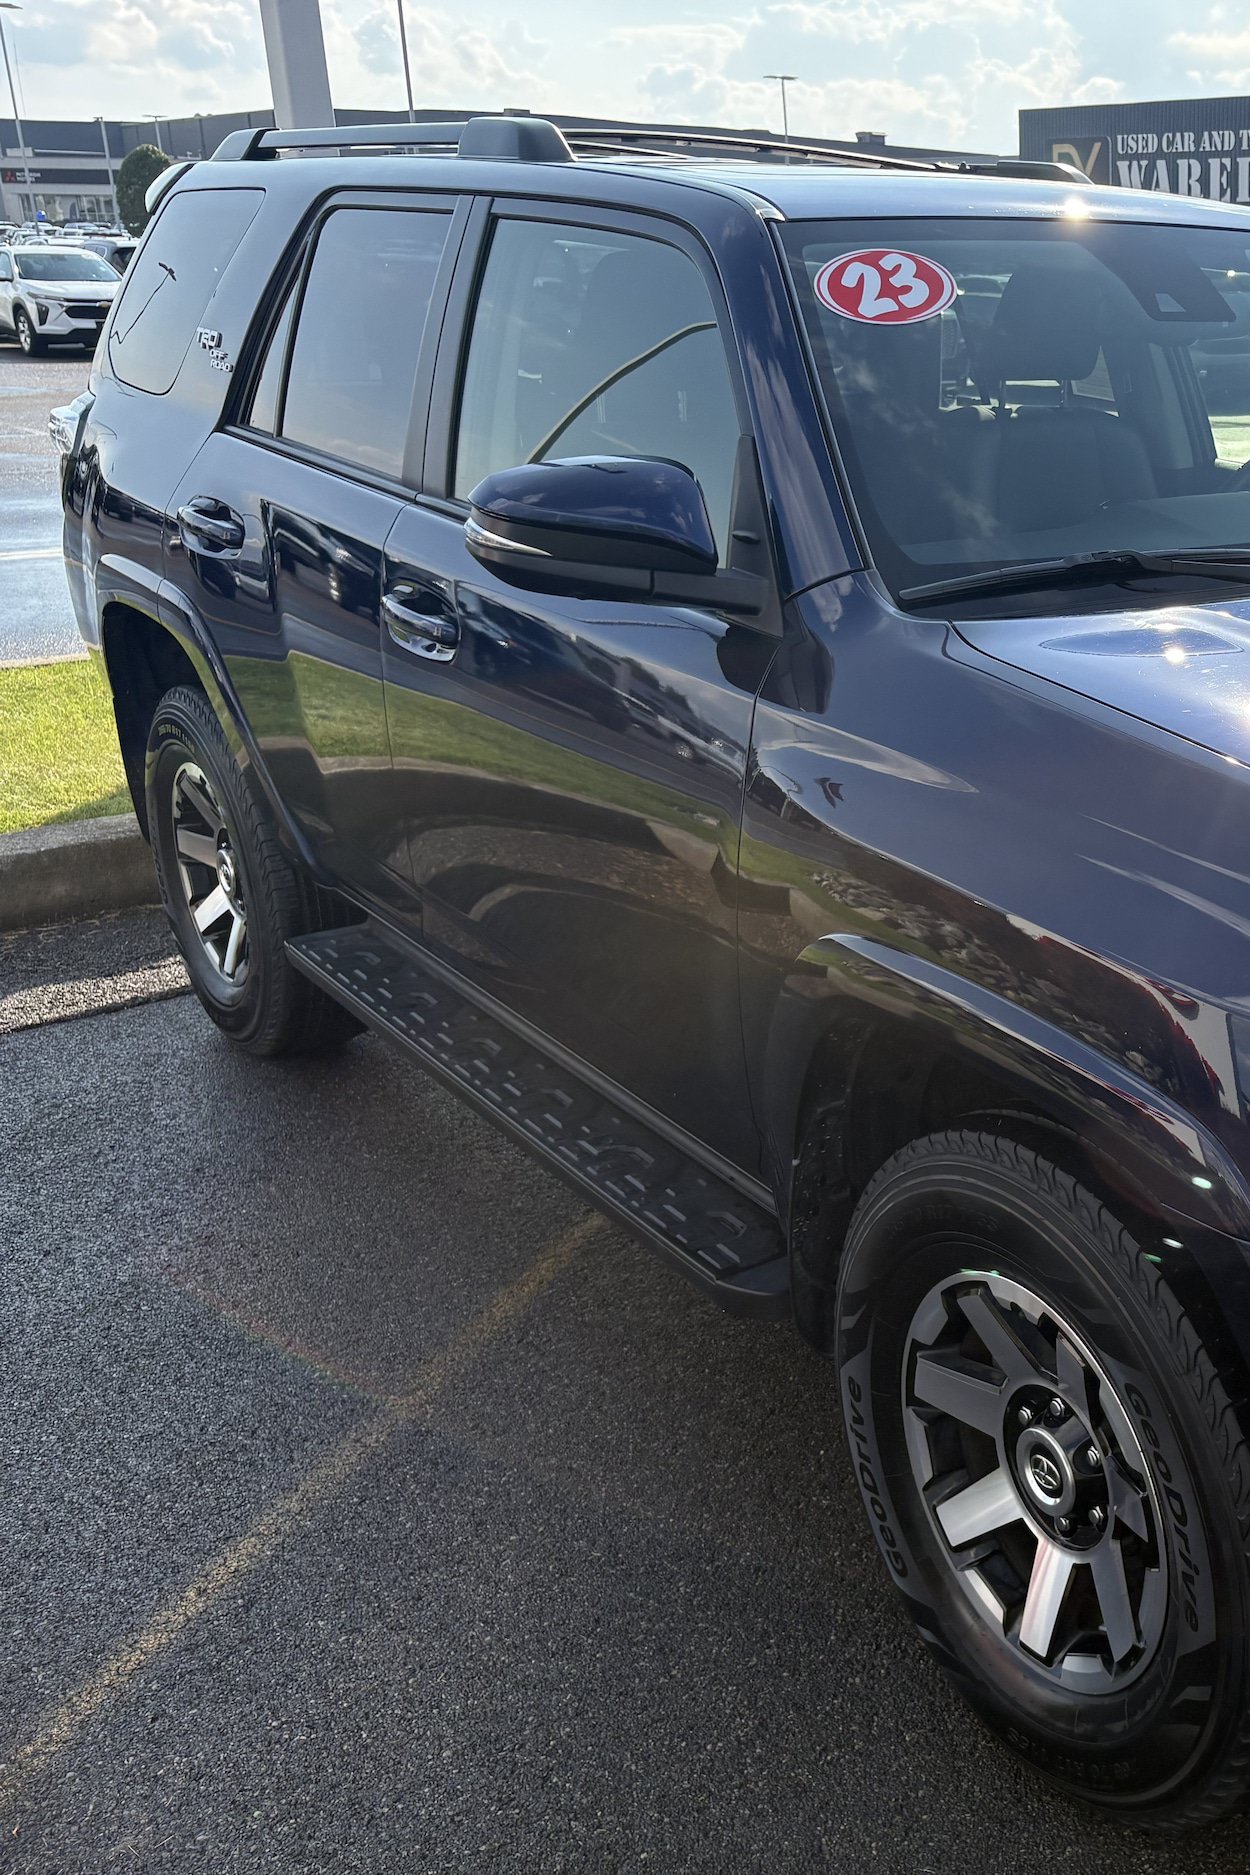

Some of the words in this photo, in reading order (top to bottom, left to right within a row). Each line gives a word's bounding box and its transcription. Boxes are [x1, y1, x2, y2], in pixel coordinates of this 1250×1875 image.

[1116, 133, 1159, 154] USED
[1161, 131, 1196, 153] CAR
[1199, 130, 1236, 151] AND
[840, 253, 930, 318] 23
[196, 326, 222, 350] TRD
[210, 359, 234, 372] ROAD
[847, 1372, 909, 1579] GeoDrive
[1123, 1381, 1201, 1634] GeoDrive
